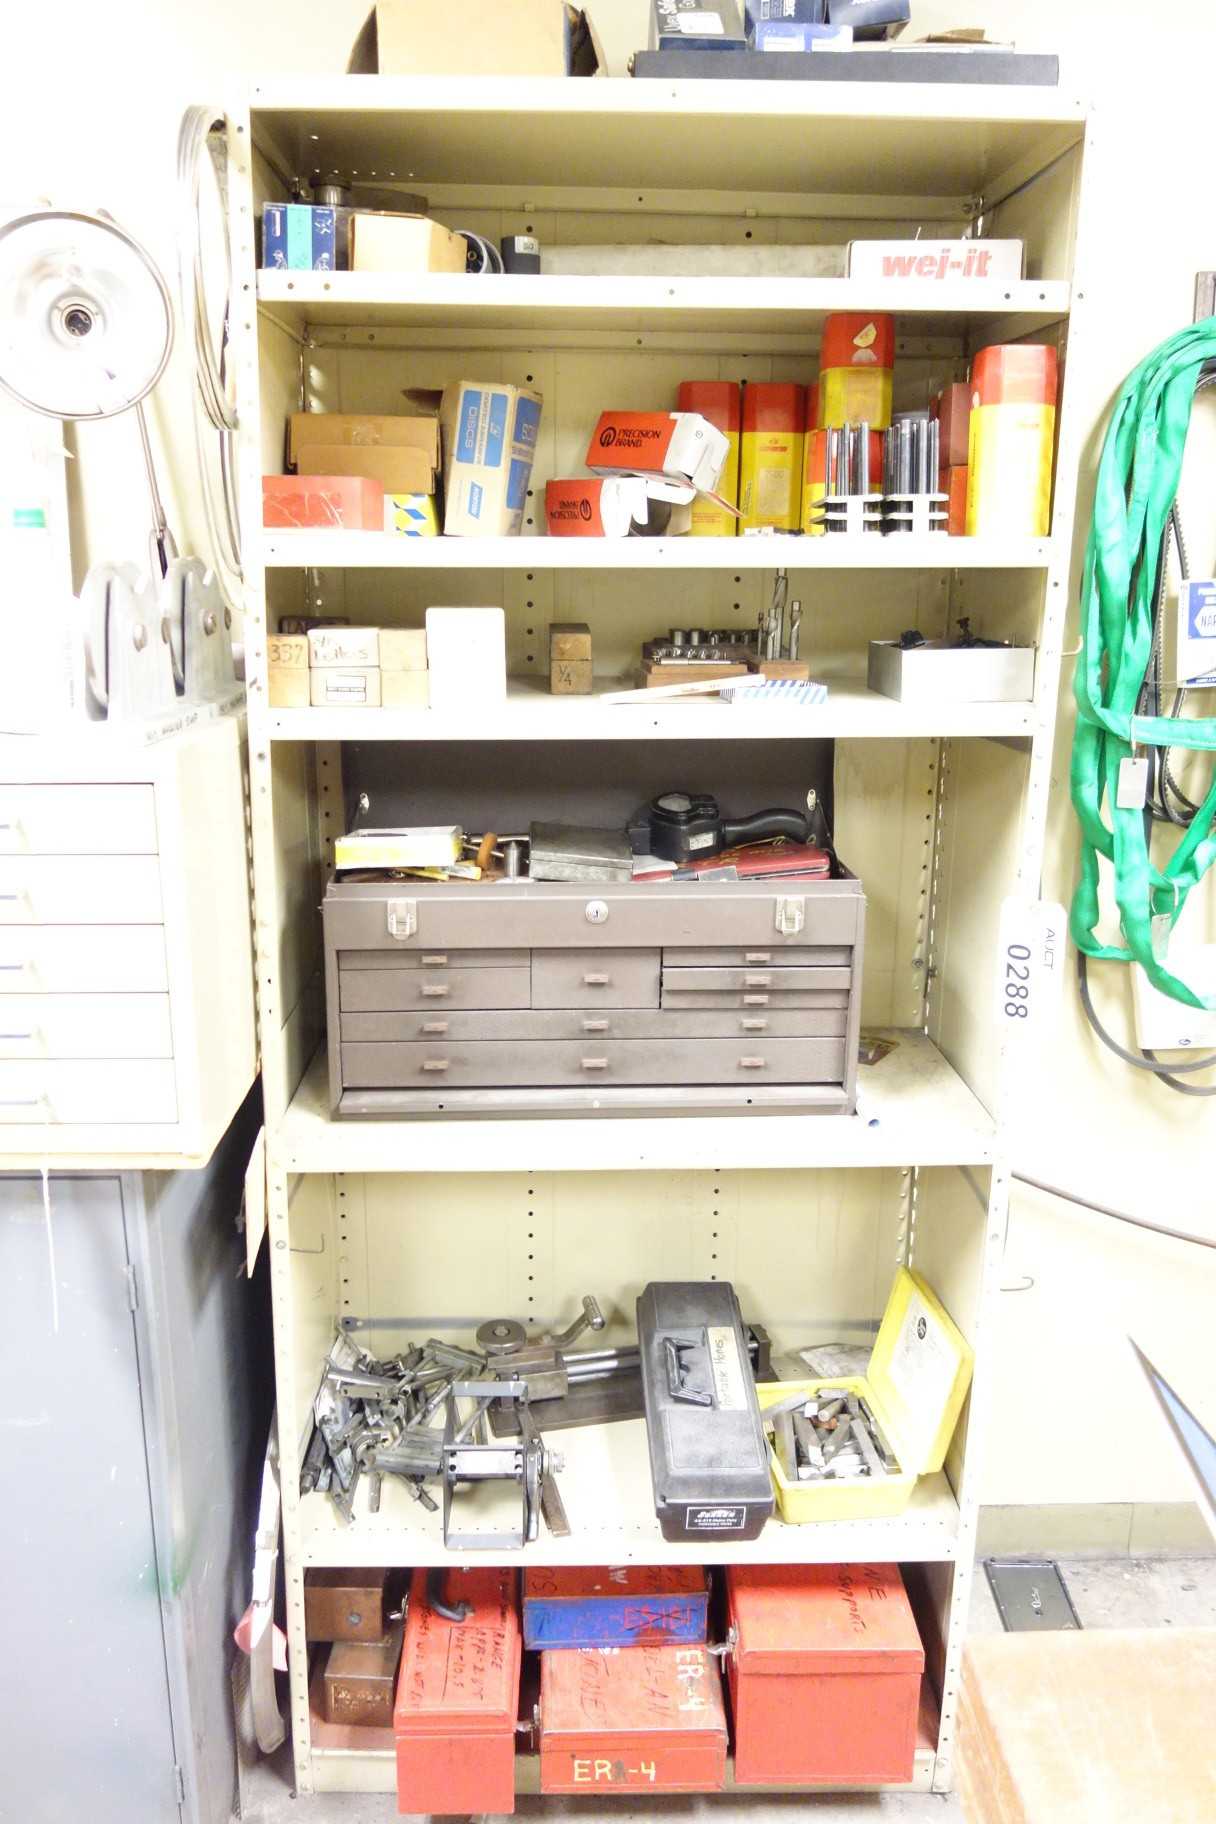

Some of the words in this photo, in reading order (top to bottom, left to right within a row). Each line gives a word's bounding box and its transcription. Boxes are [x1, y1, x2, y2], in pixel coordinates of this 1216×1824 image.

[618, 428, 662, 440] PRECISION
[615, 438, 643, 448] BRAND
[1004, 944, 1032, 1019] 0288
